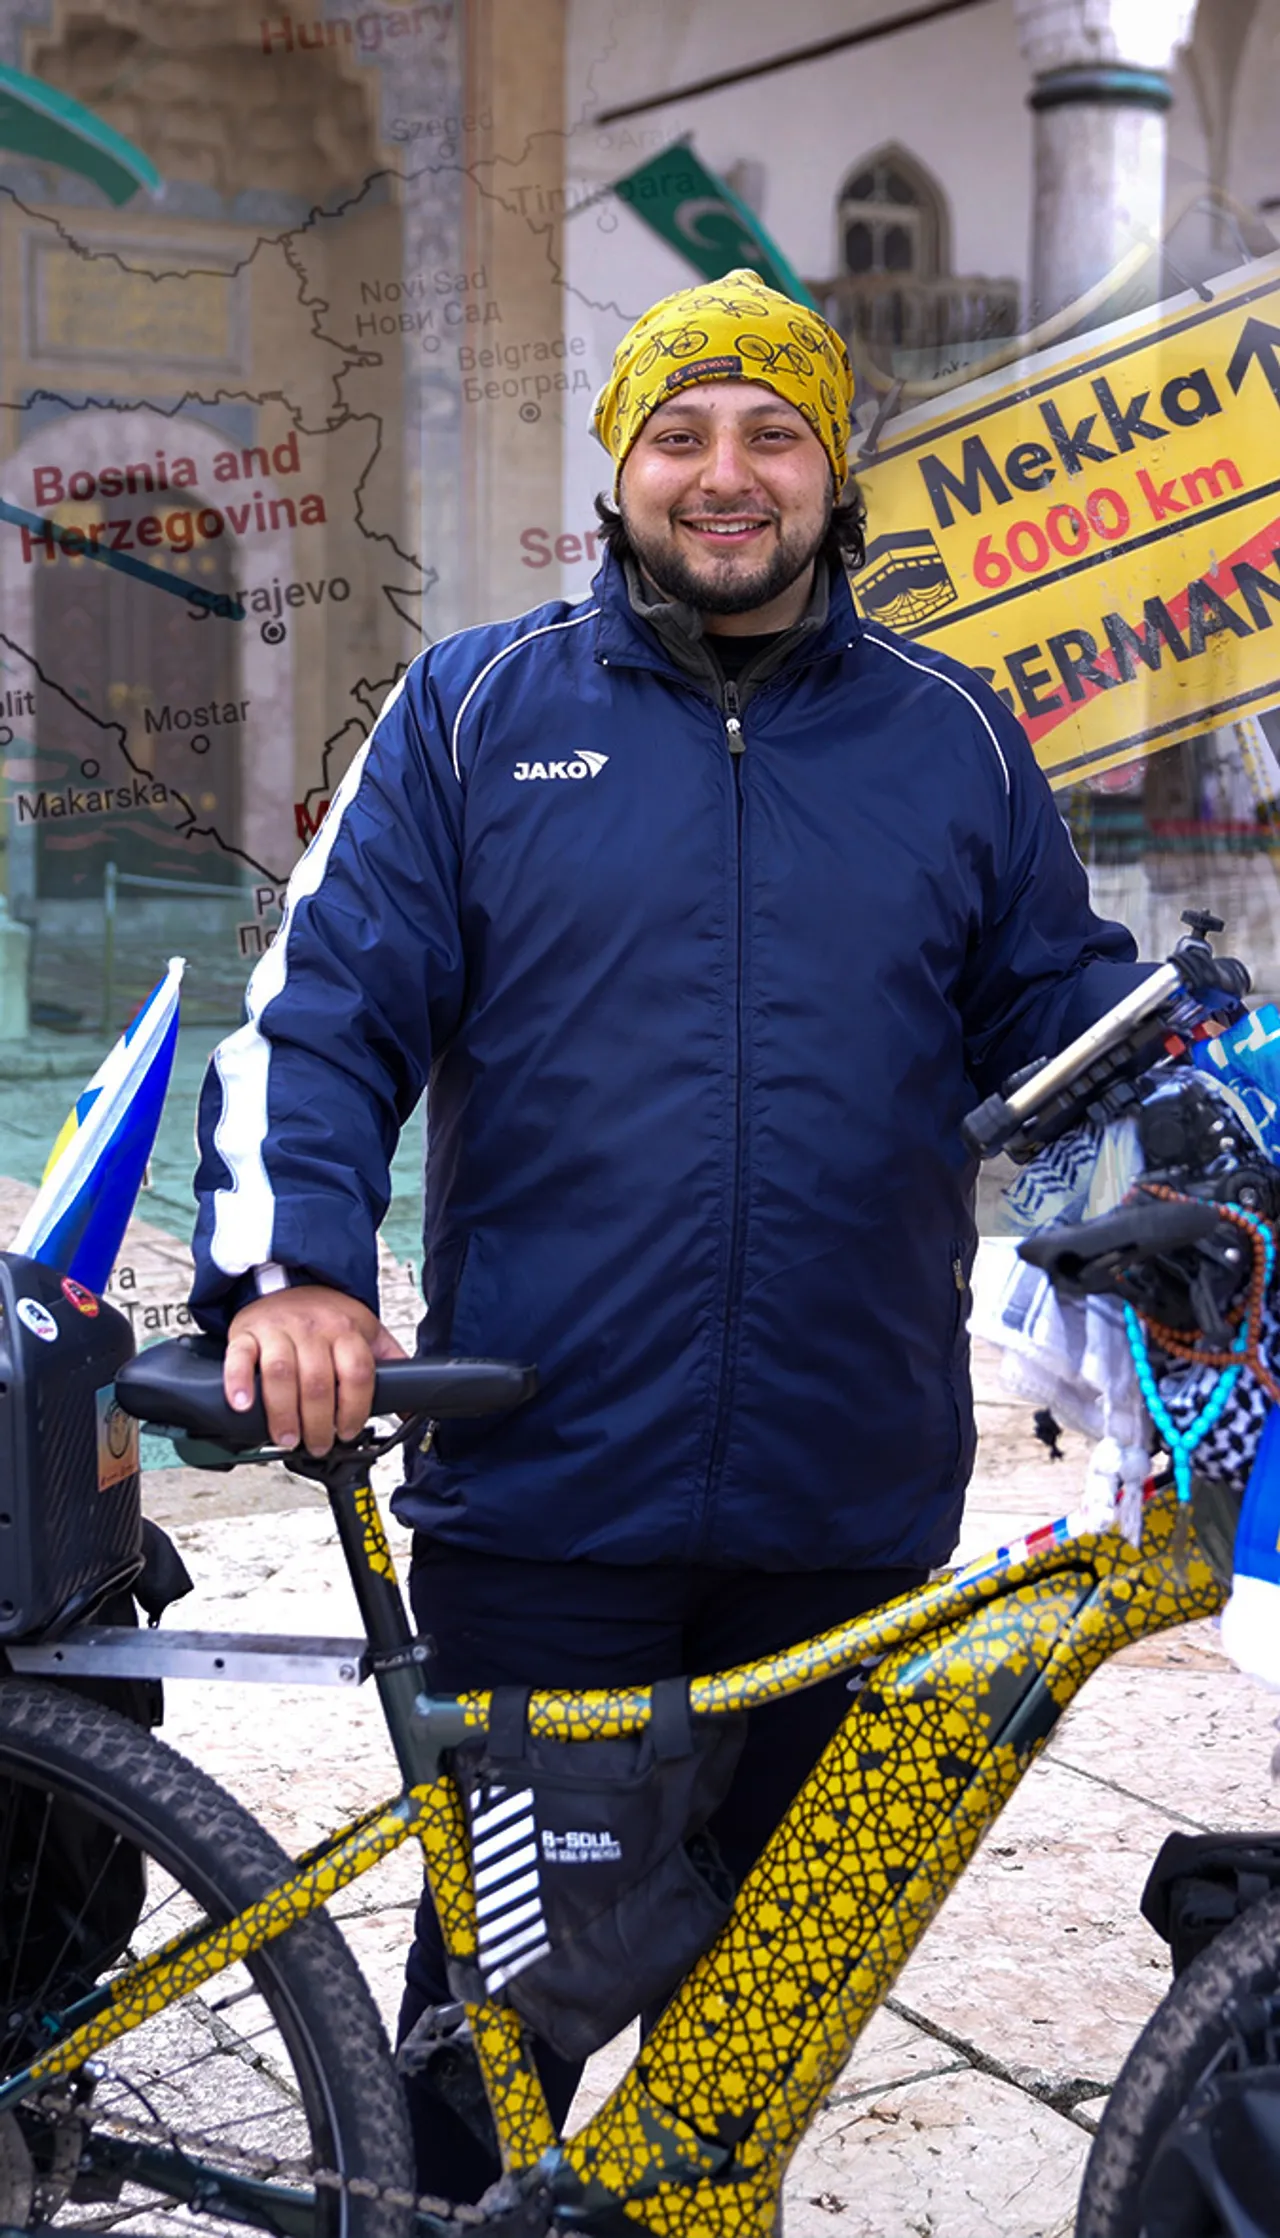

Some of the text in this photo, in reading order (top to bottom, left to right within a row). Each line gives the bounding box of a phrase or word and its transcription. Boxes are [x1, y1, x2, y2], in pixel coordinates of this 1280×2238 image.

[917, 366, 1223, 529] Mekka
[972, 457, 1244, 590] 6000 km
[513, 761, 588, 781] JAKO
[542, 1830, 620, 1849] B-SOUL
